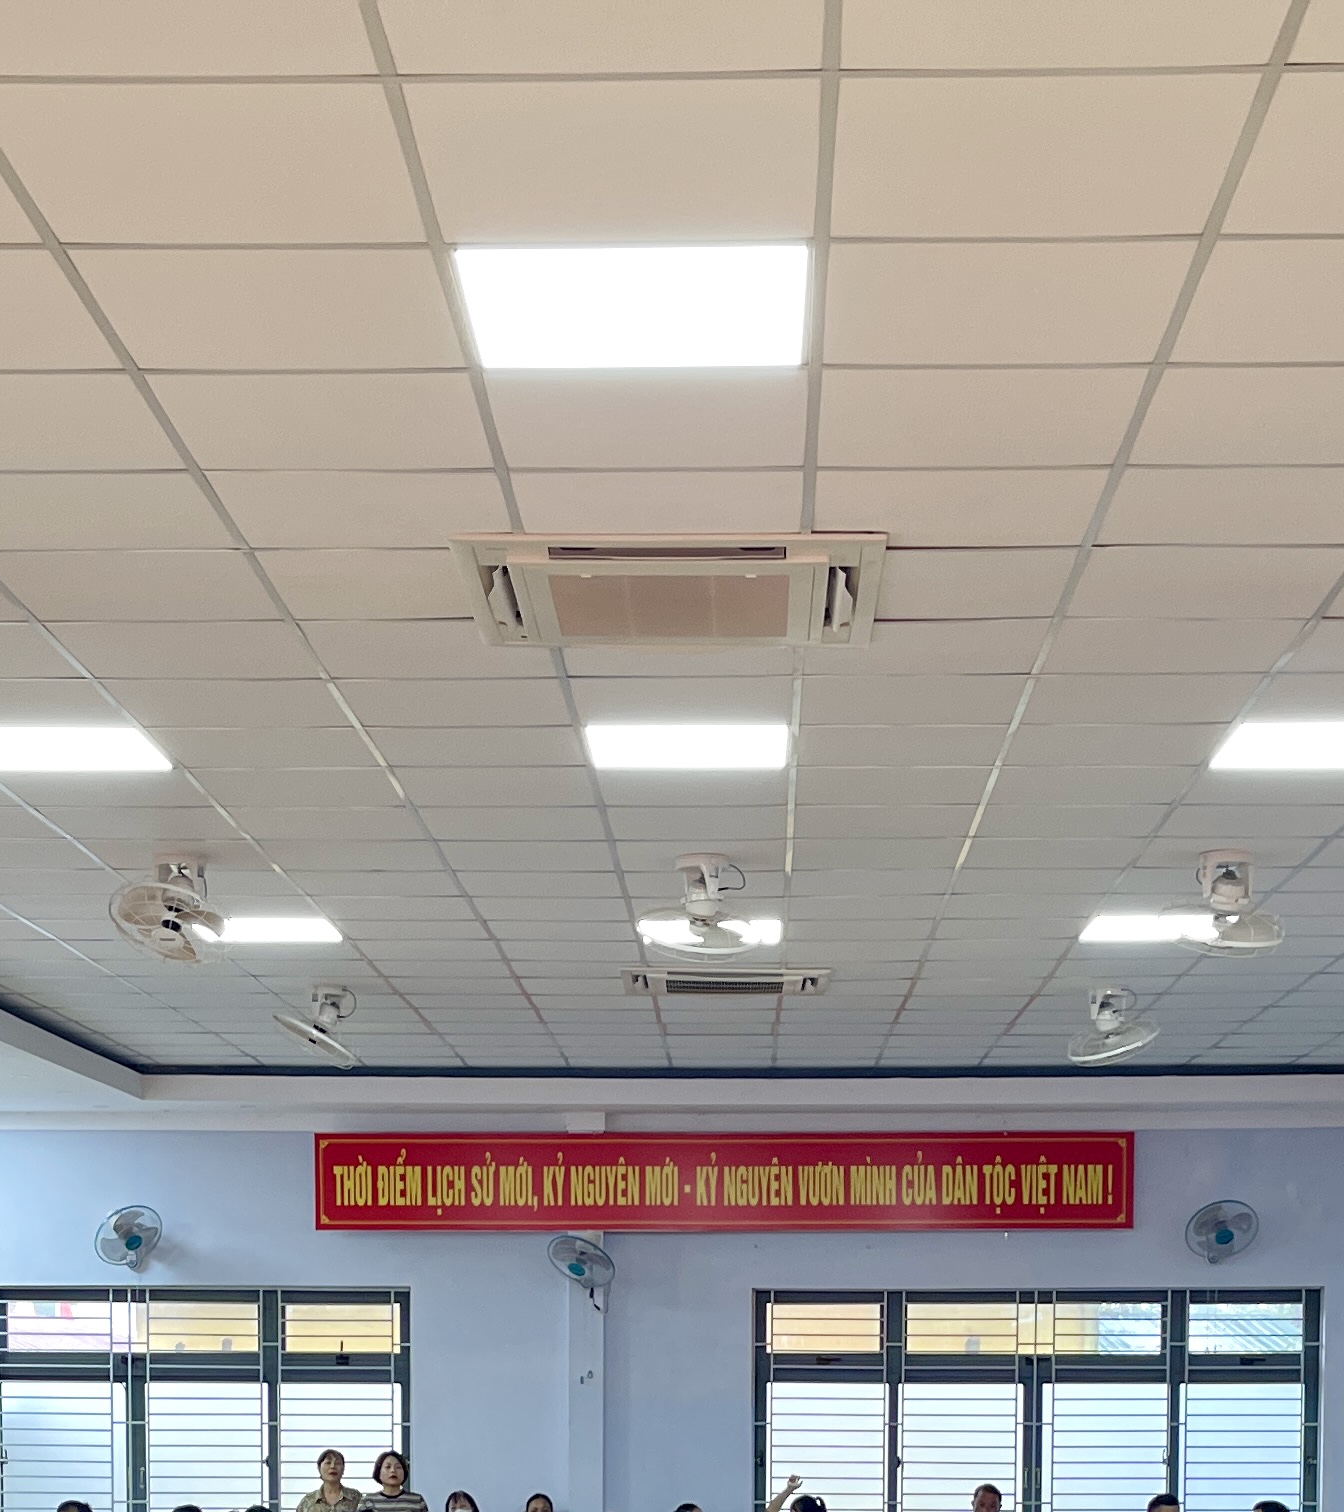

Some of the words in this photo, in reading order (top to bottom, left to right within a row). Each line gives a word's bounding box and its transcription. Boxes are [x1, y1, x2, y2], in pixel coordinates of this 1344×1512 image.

[332, 1155, 373, 1207] THỜI
[376, 1149, 423, 1207] ĐIỂM
[427, 1165, 466, 1216] LỊCH
[470, 1152, 497, 1206] SỬ
[499, 1157, 538, 1212] MỚI,
[543, 1152, 565, 1206] KỶ
[570, 1157, 640, 1206] NGUYÊN
[645, 1157, 679, 1206] MỚI
[695, 1152, 718, 1206] KỶ
[723, 1157, 793, 1206] NGUYÊN
[798, 1161, 845, 1206] VƯƠN
[849, 1155, 897, 1206] MÌNH
[901, 1150, 937, 1206] CỦA
[941, 1155, 978, 1206] DÂN
[982, 1155, 1016, 1214] TỘC
[1020, 1155, 1058, 1214] VIỆT
